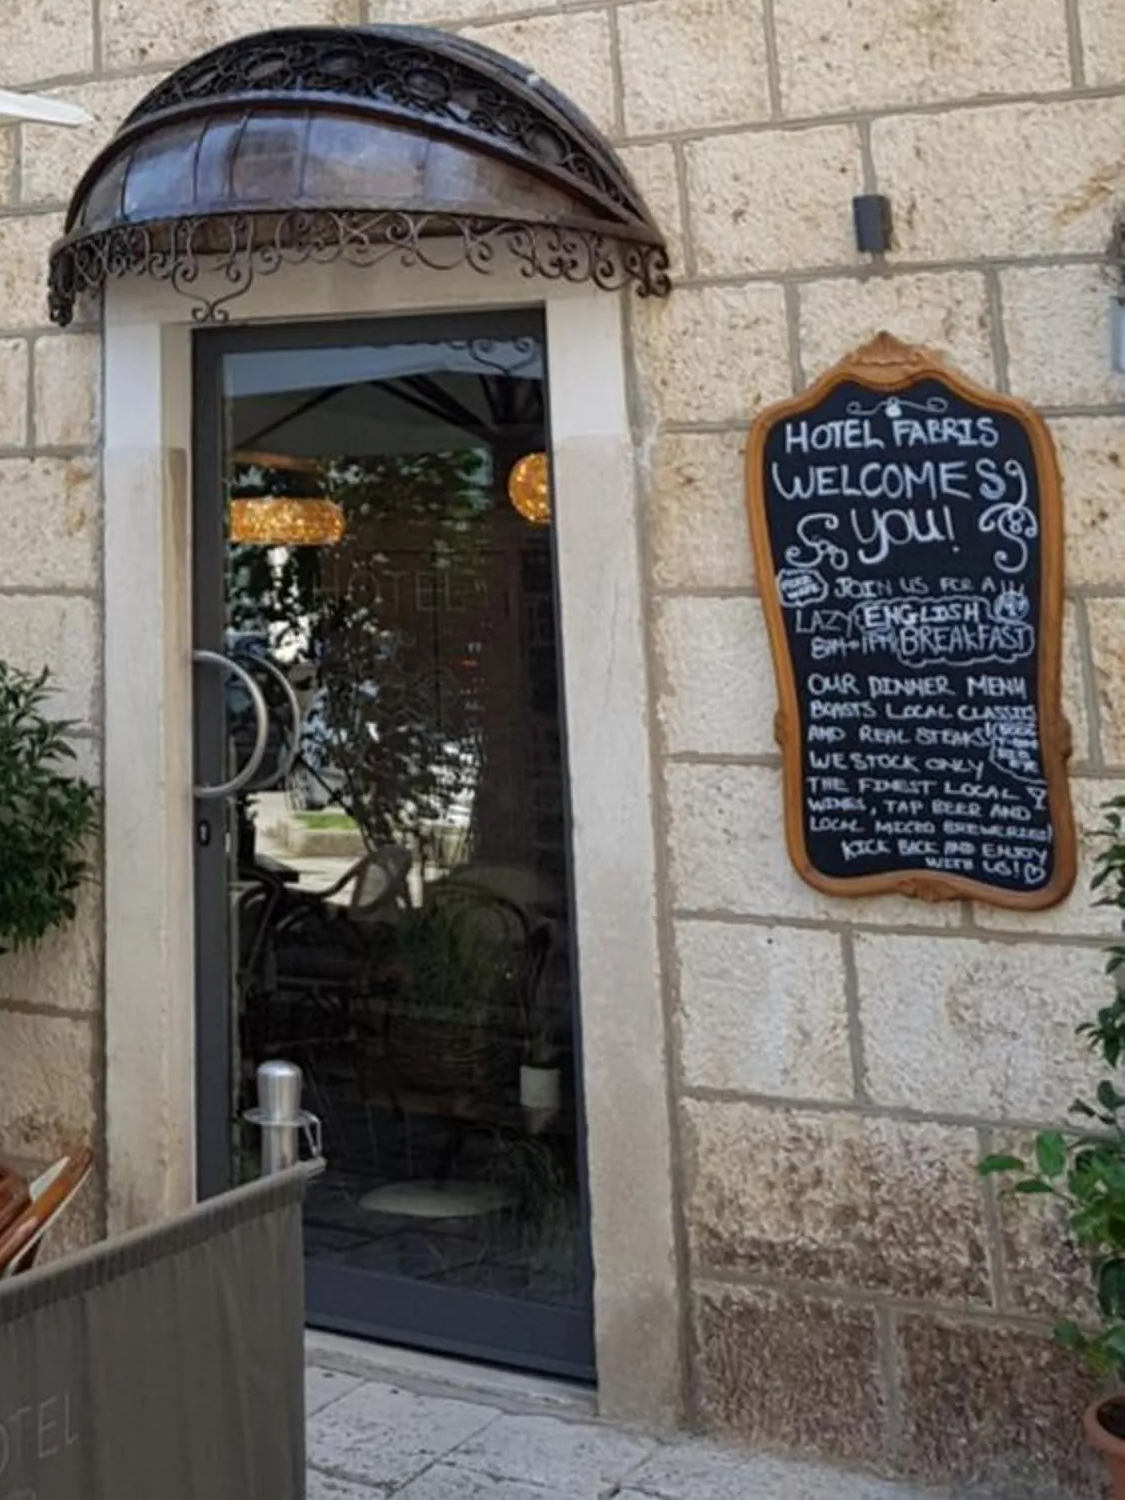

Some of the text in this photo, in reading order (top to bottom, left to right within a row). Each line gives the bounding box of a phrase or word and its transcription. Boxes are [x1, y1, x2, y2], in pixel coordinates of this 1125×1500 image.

[785, 416, 999, 453] HOTEL FABRIS
[771, 457, 1006, 501] WELCOMES
[834, 578, 892, 598] JOIN
[899, 578, 928, 595] US
[940, 577, 973, 592] FOR
[981, 576, 996, 592] A
[795, 602, 980, 637] LAZY ENGLISH
[899, 624, 1026, 656] BREAKFAST
[808, 673, 1027, 699] OUR DINNER MENU
[811, 699, 877, 719] BOASTS
[885, 702, 953, 719] LOCAL
[808, 725, 846, 743] AND
[859, 724, 911, 744] REAL
[809, 751, 847, 769] WE
[850, 753, 920, 772] STOCK
[926, 758, 984, 780] ONLY
[807, 777, 1021, 800] THE FINEST LOCAL
[882, 800, 923, 815] TAP
[931, 800, 982, 817] BEER
[990, 805, 1031, 821] AND
[810, 817, 865, 832] LOCAL
[876, 820, 935, 834] MICRO
[841, 839, 1047, 864] KICK BACK AND ENJOY
[925, 857, 975, 871] WITH
